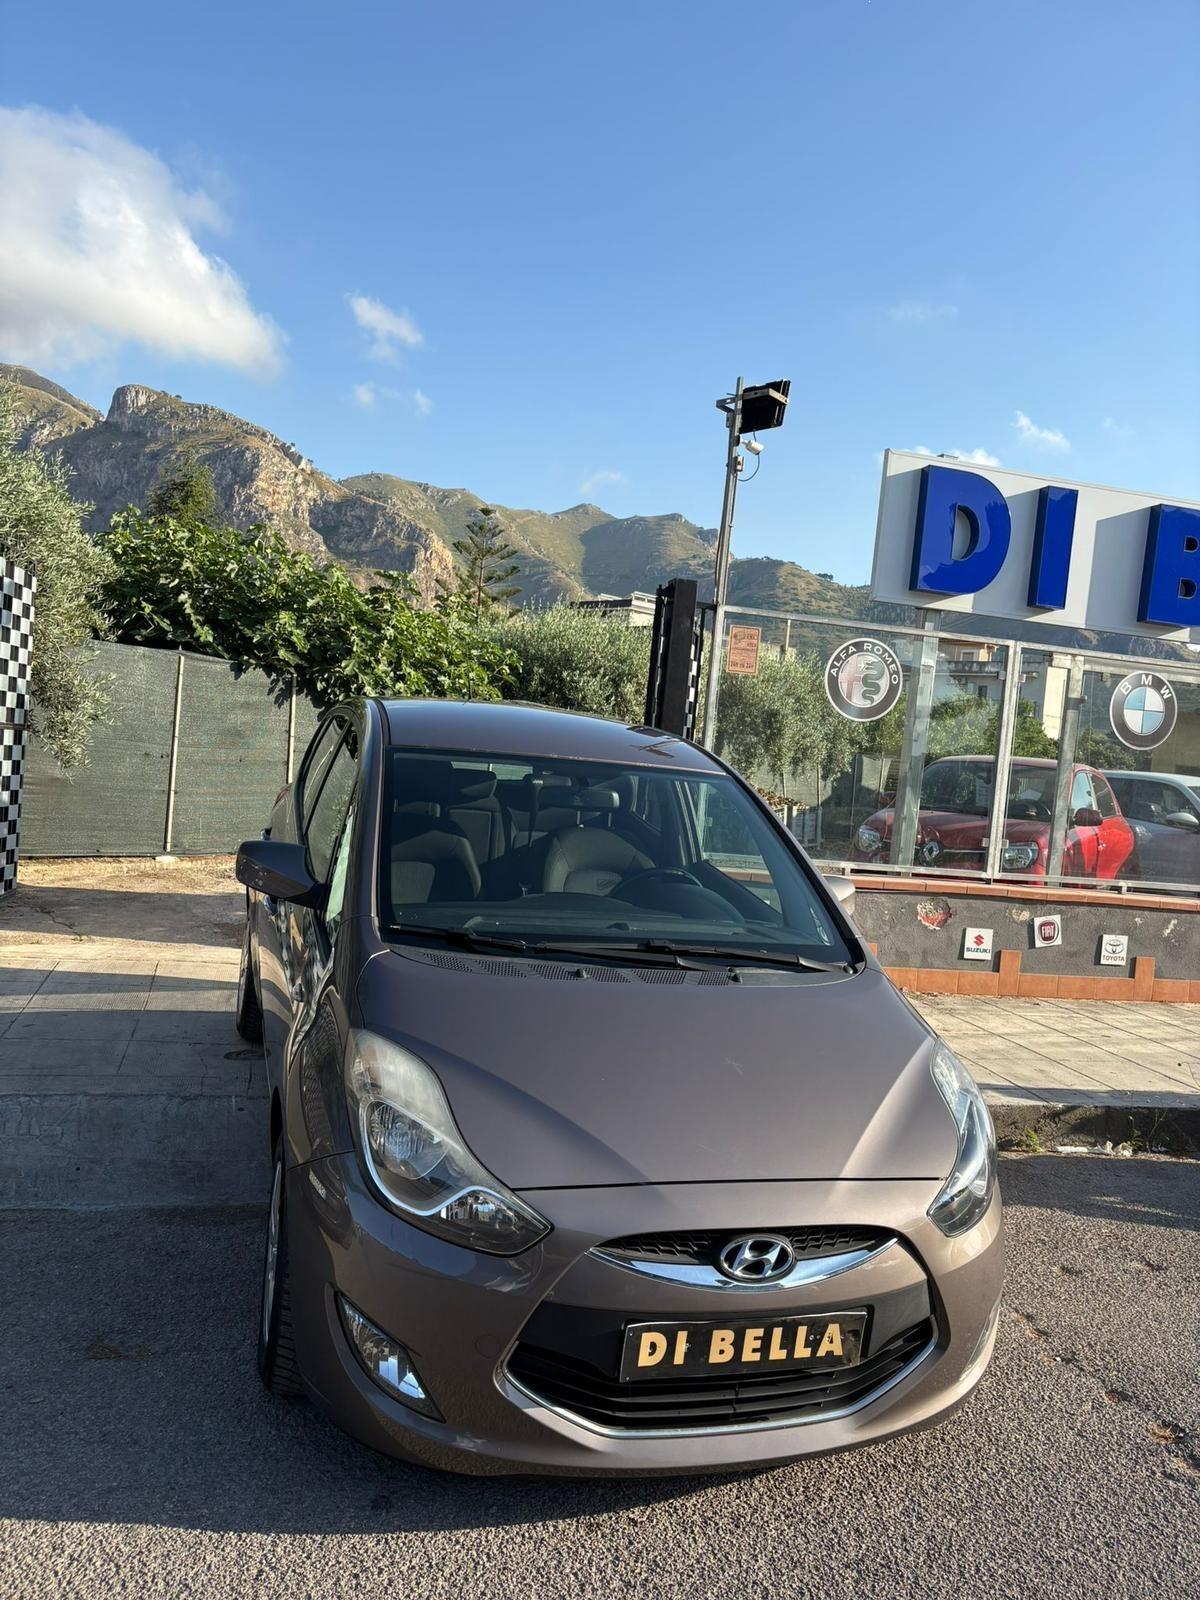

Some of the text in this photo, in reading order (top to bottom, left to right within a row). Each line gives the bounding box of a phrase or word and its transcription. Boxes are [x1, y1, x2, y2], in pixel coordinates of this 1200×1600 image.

[909, 465, 1078, 610] DI
[830, 643, 899, 684] ALFA ROMEO
[1120, 674, 1172, 699] BMW
[1041, 925, 1054, 937] FIAT
[638, 1324, 843, 1367] DI BELLA
